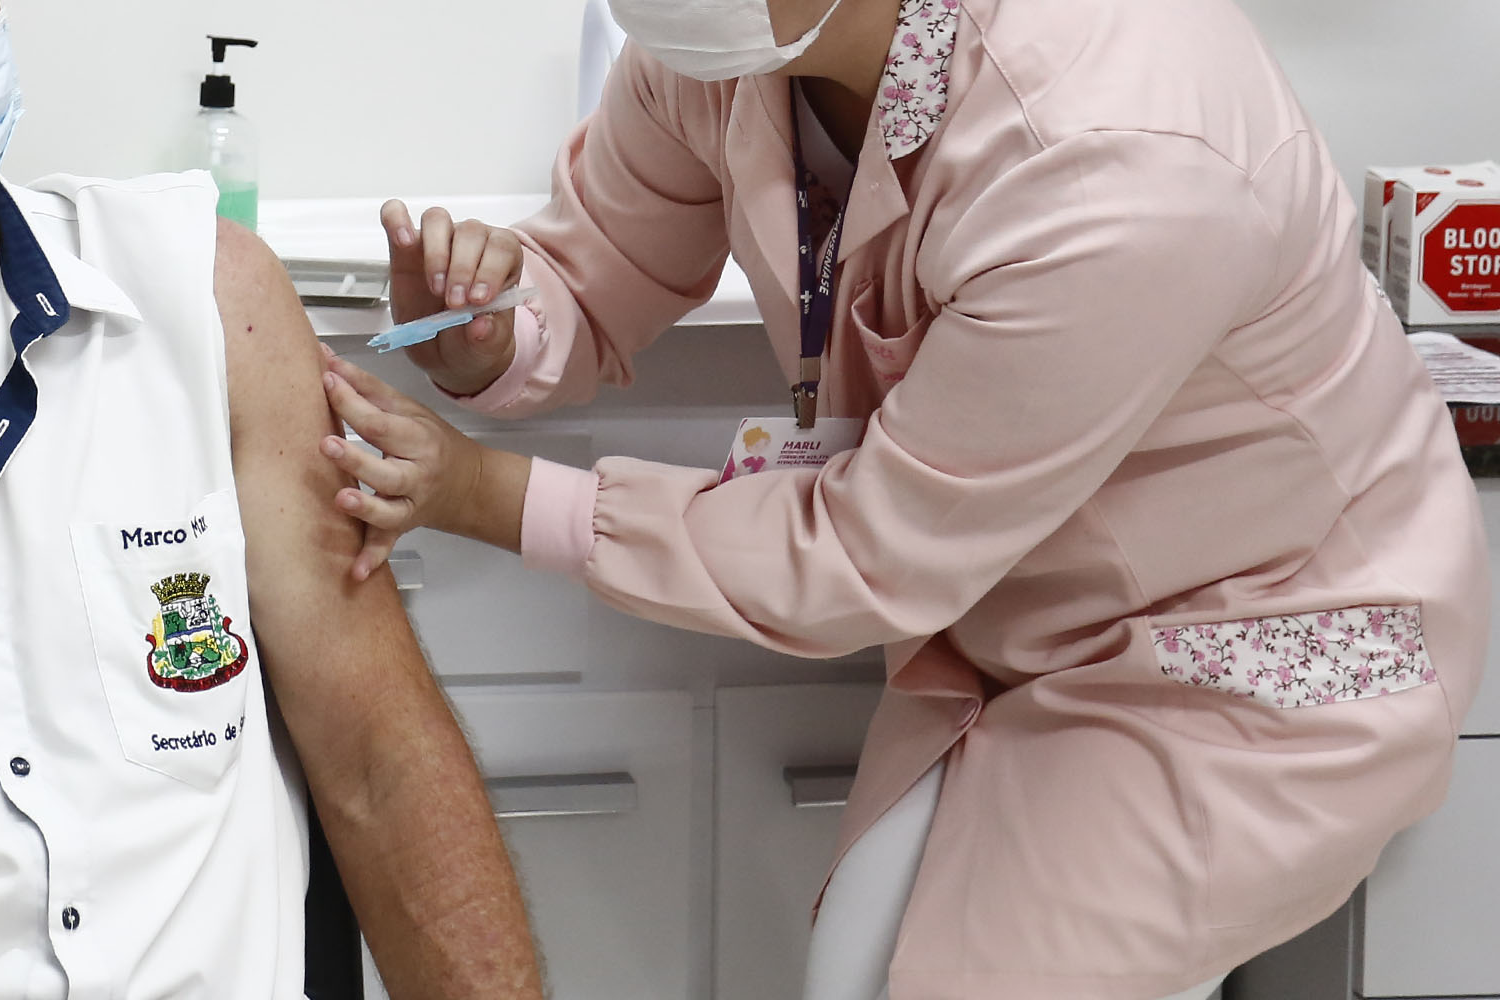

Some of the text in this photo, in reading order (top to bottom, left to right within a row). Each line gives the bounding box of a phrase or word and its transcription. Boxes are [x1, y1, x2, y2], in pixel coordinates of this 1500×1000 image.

[782, 440, 821, 450] MARLI
[120, 527, 187, 550] Marco
[151, 729, 217, 751] Secretário
[224, 722, 237, 741] de
